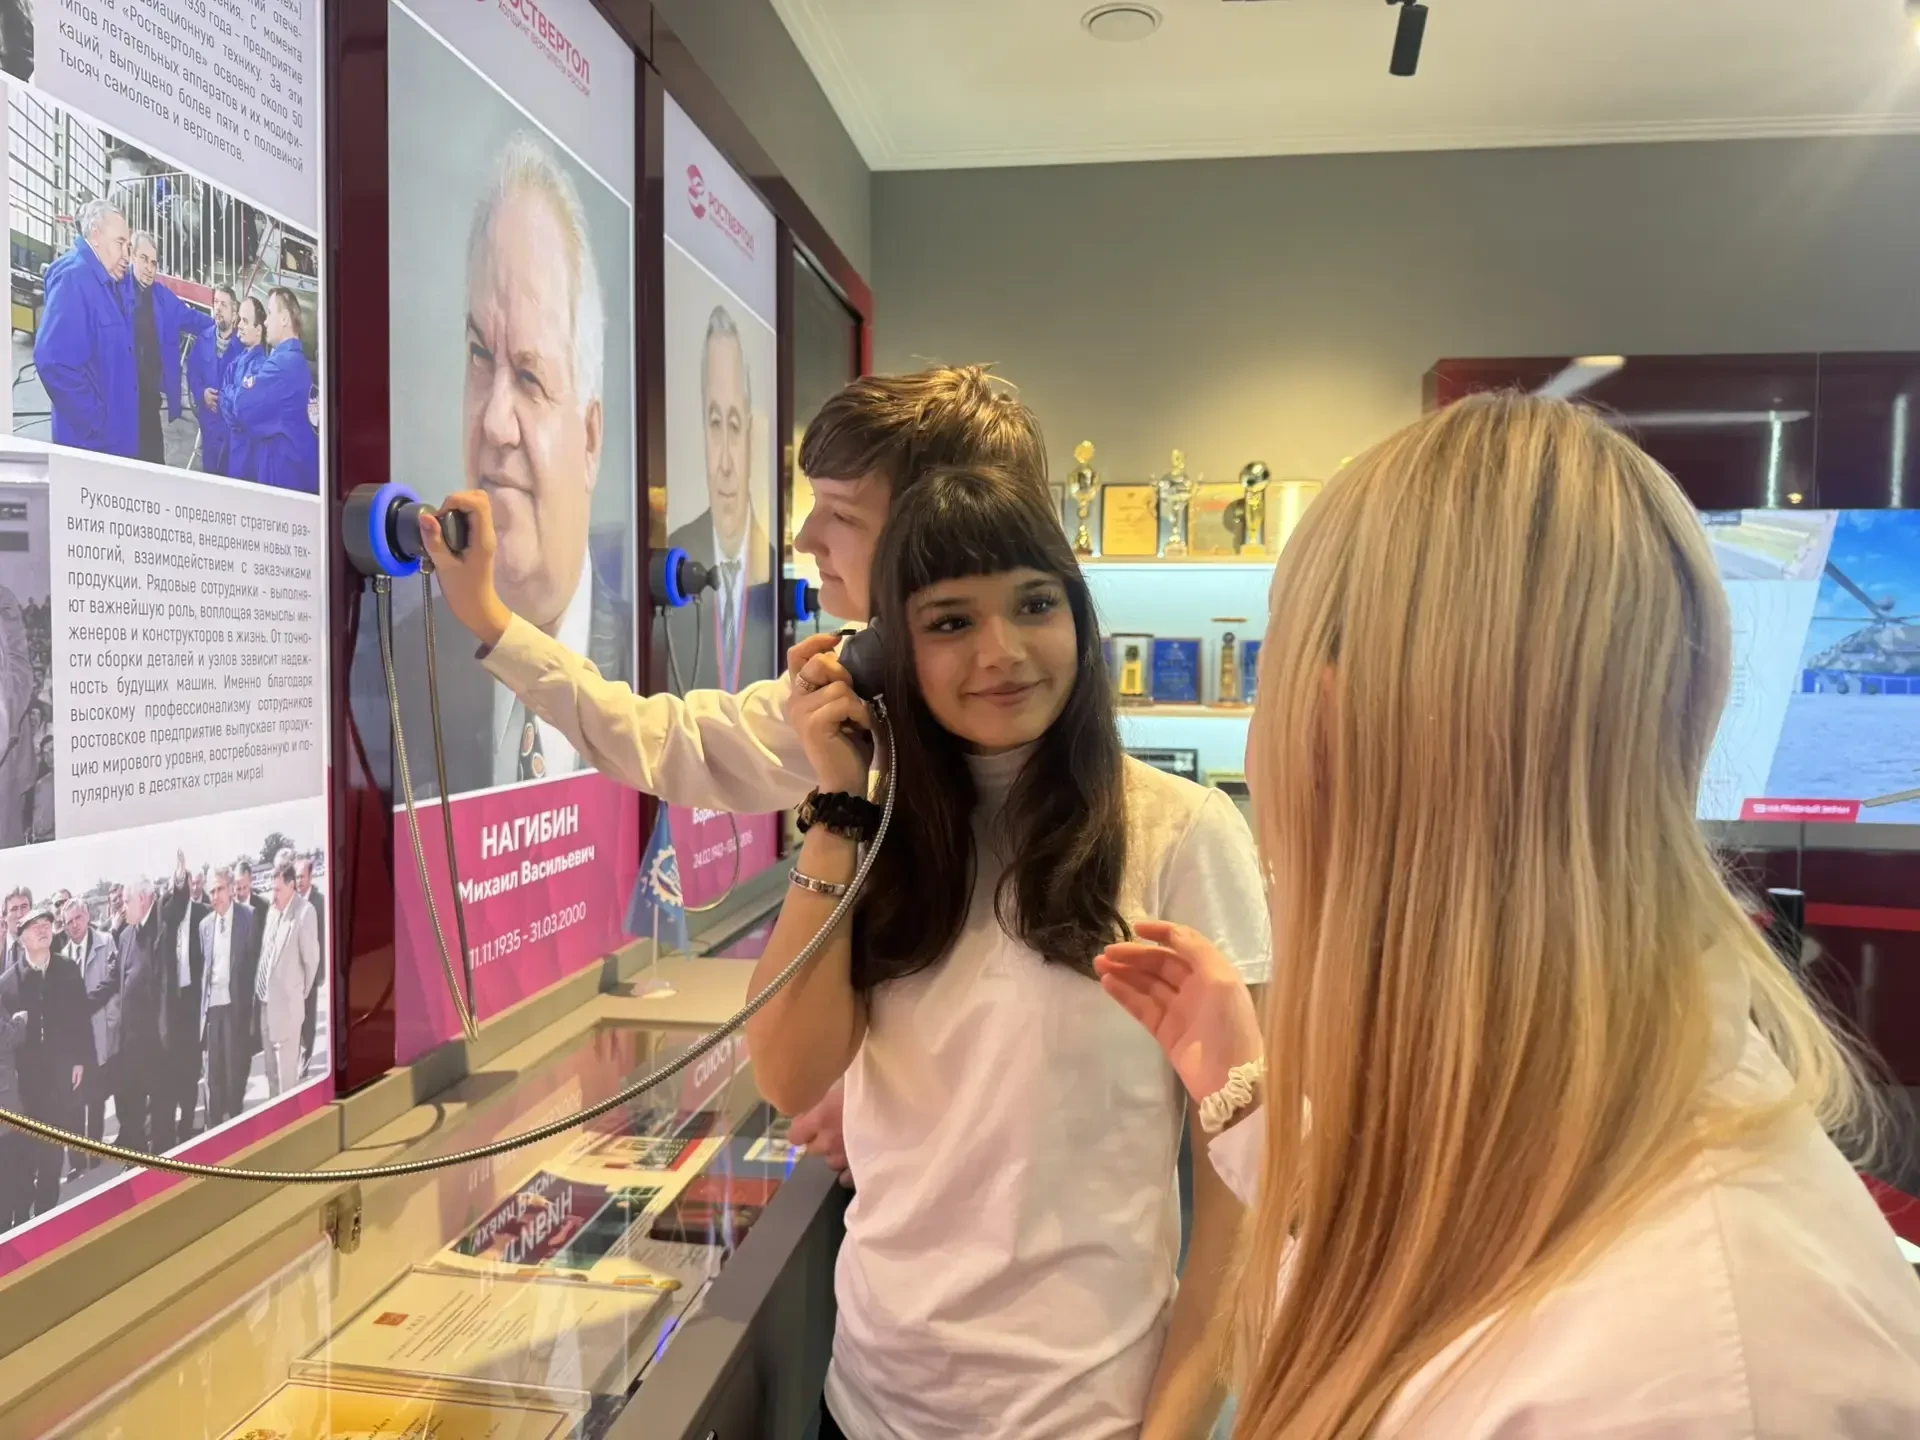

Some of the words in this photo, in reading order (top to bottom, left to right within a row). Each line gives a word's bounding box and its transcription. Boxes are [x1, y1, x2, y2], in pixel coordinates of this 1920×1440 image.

[251, 14, 256, 30] С
[263, 26, 302, 63] момента
[273, 11, 302, 37] отече-
[509, 0, 590, 85] СТВЕРТОЛ
[122, 5, 208, 66] «Роствертоле»
[213, 63, 256, 99] освоено
[260, 93, 288, 119] около
[292, 110, 303, 129] 50
[140, 0, 215, 48] виационную
[223, 44, 262, 82] технику.
[269, 73, 281, 92] За
[288, 88, 302, 107] эти
[209, 11, 231, 36] года
[243, 35, 302, 85] предприятие
[59, 19, 103, 60] каций,
[109, 49, 173, 97] выпущено
[178, 87, 211, 119] более
[216, 112, 239, 136] пяти
[243, 128, 250, 141] с
[254, 134, 303, 174] половиной
[59, 47, 100, 82] тысяч
[104, 73, 169, 120] самолетов
[172, 110, 179, 126] и
[183, 117, 245, 162] вертолетов.
[102, 18, 180, 76] летательных
[182, 67, 238, 111] аппаратов
[240, 103, 247, 117] и
[249, 108, 261, 125] их
[263, 117, 303, 149] модифи-
[80, 487, 161, 515] Руководство
[174, 504, 238, 527] определяет
[240, 516, 289, 535] стратегию
[292, 523, 311, 538] раз-
[67, 516, 105, 534] вития
[109, 520, 196, 547] производства,
[198, 533, 261, 553] внедрением
[263, 541, 292, 556] новых
[294, 544, 311, 559] тех-
[68, 543, 125, 565] нологий,
[134, 551, 235, 574] взаимодействием
[241, 562, 248, 574] с
[253, 562, 312, 580] заказчиками
[68, 570, 141, 591] продукции.
[147, 574, 197, 593] Рядовые
[201, 581, 259, 600] сотрудники
[270, 587, 312, 601] выполня-
[68, 598, 85, 614] ют
[89, 599, 165, 621] важнейшую
[168, 603, 197, 623] роль,
[200, 606, 251, 623] воплощая
[253, 608, 296, 623] замыслы
[297, 611, 312, 623] ин-
[68, 625, 128, 645] женеров
[131, 626, 138, 641] и
[142, 627, 225, 648] конструкторов
[227, 630, 233, 643] в
[235, 631, 269, 643] жизнь.
[270, 628, 282, 644] От
[284, 632, 312, 644] точно-
[69, 652, 92, 668] сти
[97, 649, 143, 670] сборки
[146, 650, 194, 669] деталей
[198, 652, 205, 666] и
[208, 653, 237, 669] узлов
[240, 652, 279, 667] зависит
[280, 653, 312, 667] надеж-
[70, 678, 108, 695] ность
[116, 674, 169, 697] будущих
[176, 676, 217, 692] машин.
[223, 674, 262, 689] Именно
[267, 673, 313, 691] благодаря
[70, 703, 136, 724] высокому
[144, 699, 251, 722] профессионализму
[257, 696, 313, 714] сотрудников
[71, 729, 146, 753] ростовское
[150, 723, 223, 747] предприятие
[225, 720, 277, 738] выпускает
[279, 718, 313, 735] продук-
[71, 759, 99, 778] цию
[102, 752, 162, 775] мирового
[165, 747, 207, 771] уровня,
[209, 741, 290, 762] востребованную
[291, 739, 298, 752] и
[300, 739, 314, 752] по-
[72, 783, 135, 805] пулярную
[139, 781, 146, 795] в
[149, 774, 201, 796] десятках
[203, 772, 234, 789] стран
[236, 765, 264, 785] мира!
[481, 804, 579, 860] НАГИБИН
[458, 870, 518, 905] Михаил
[521, 845, 595, 886] Васильевич
[469, 929, 521, 970] 11.11.1935
[529, 901, 587, 944] 31.03.2000
